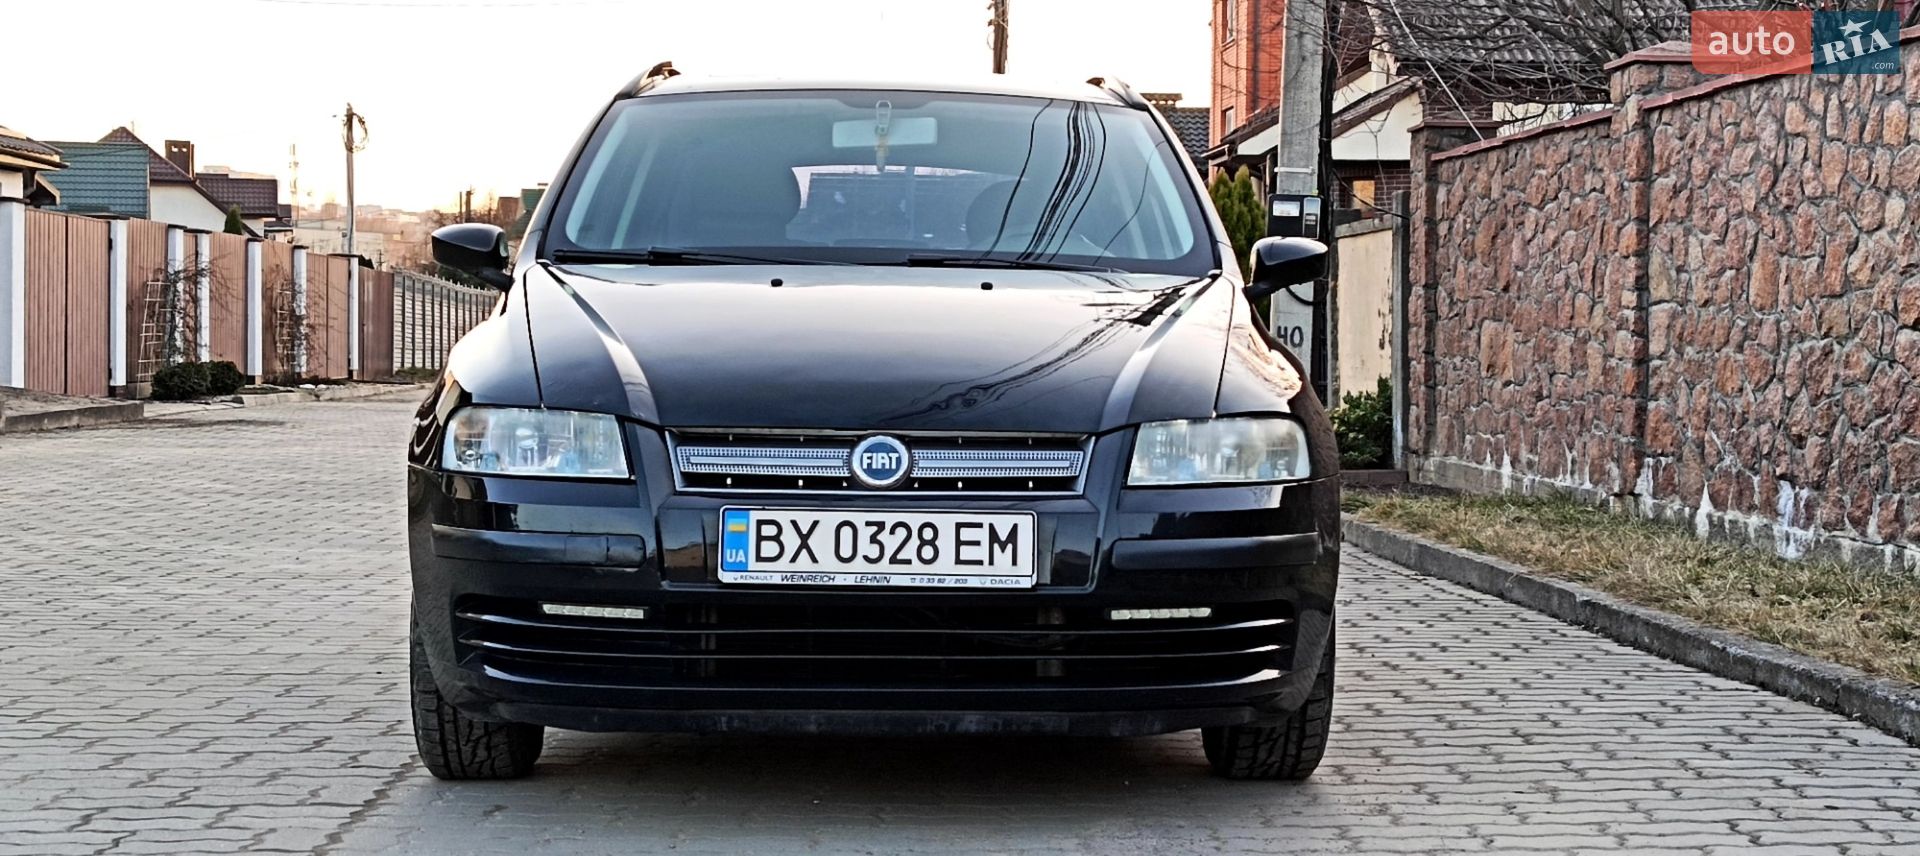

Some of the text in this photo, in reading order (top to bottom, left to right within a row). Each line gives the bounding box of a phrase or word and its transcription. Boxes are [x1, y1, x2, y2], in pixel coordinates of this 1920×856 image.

[862, 452, 899, 469] FIAT
[755, 519, 1018, 567] BX 0328 EM
[726, 549, 746, 563] UA
[780, 574, 836, 583] WEINREICH
[854, 575, 891, 584] LEHNIN
